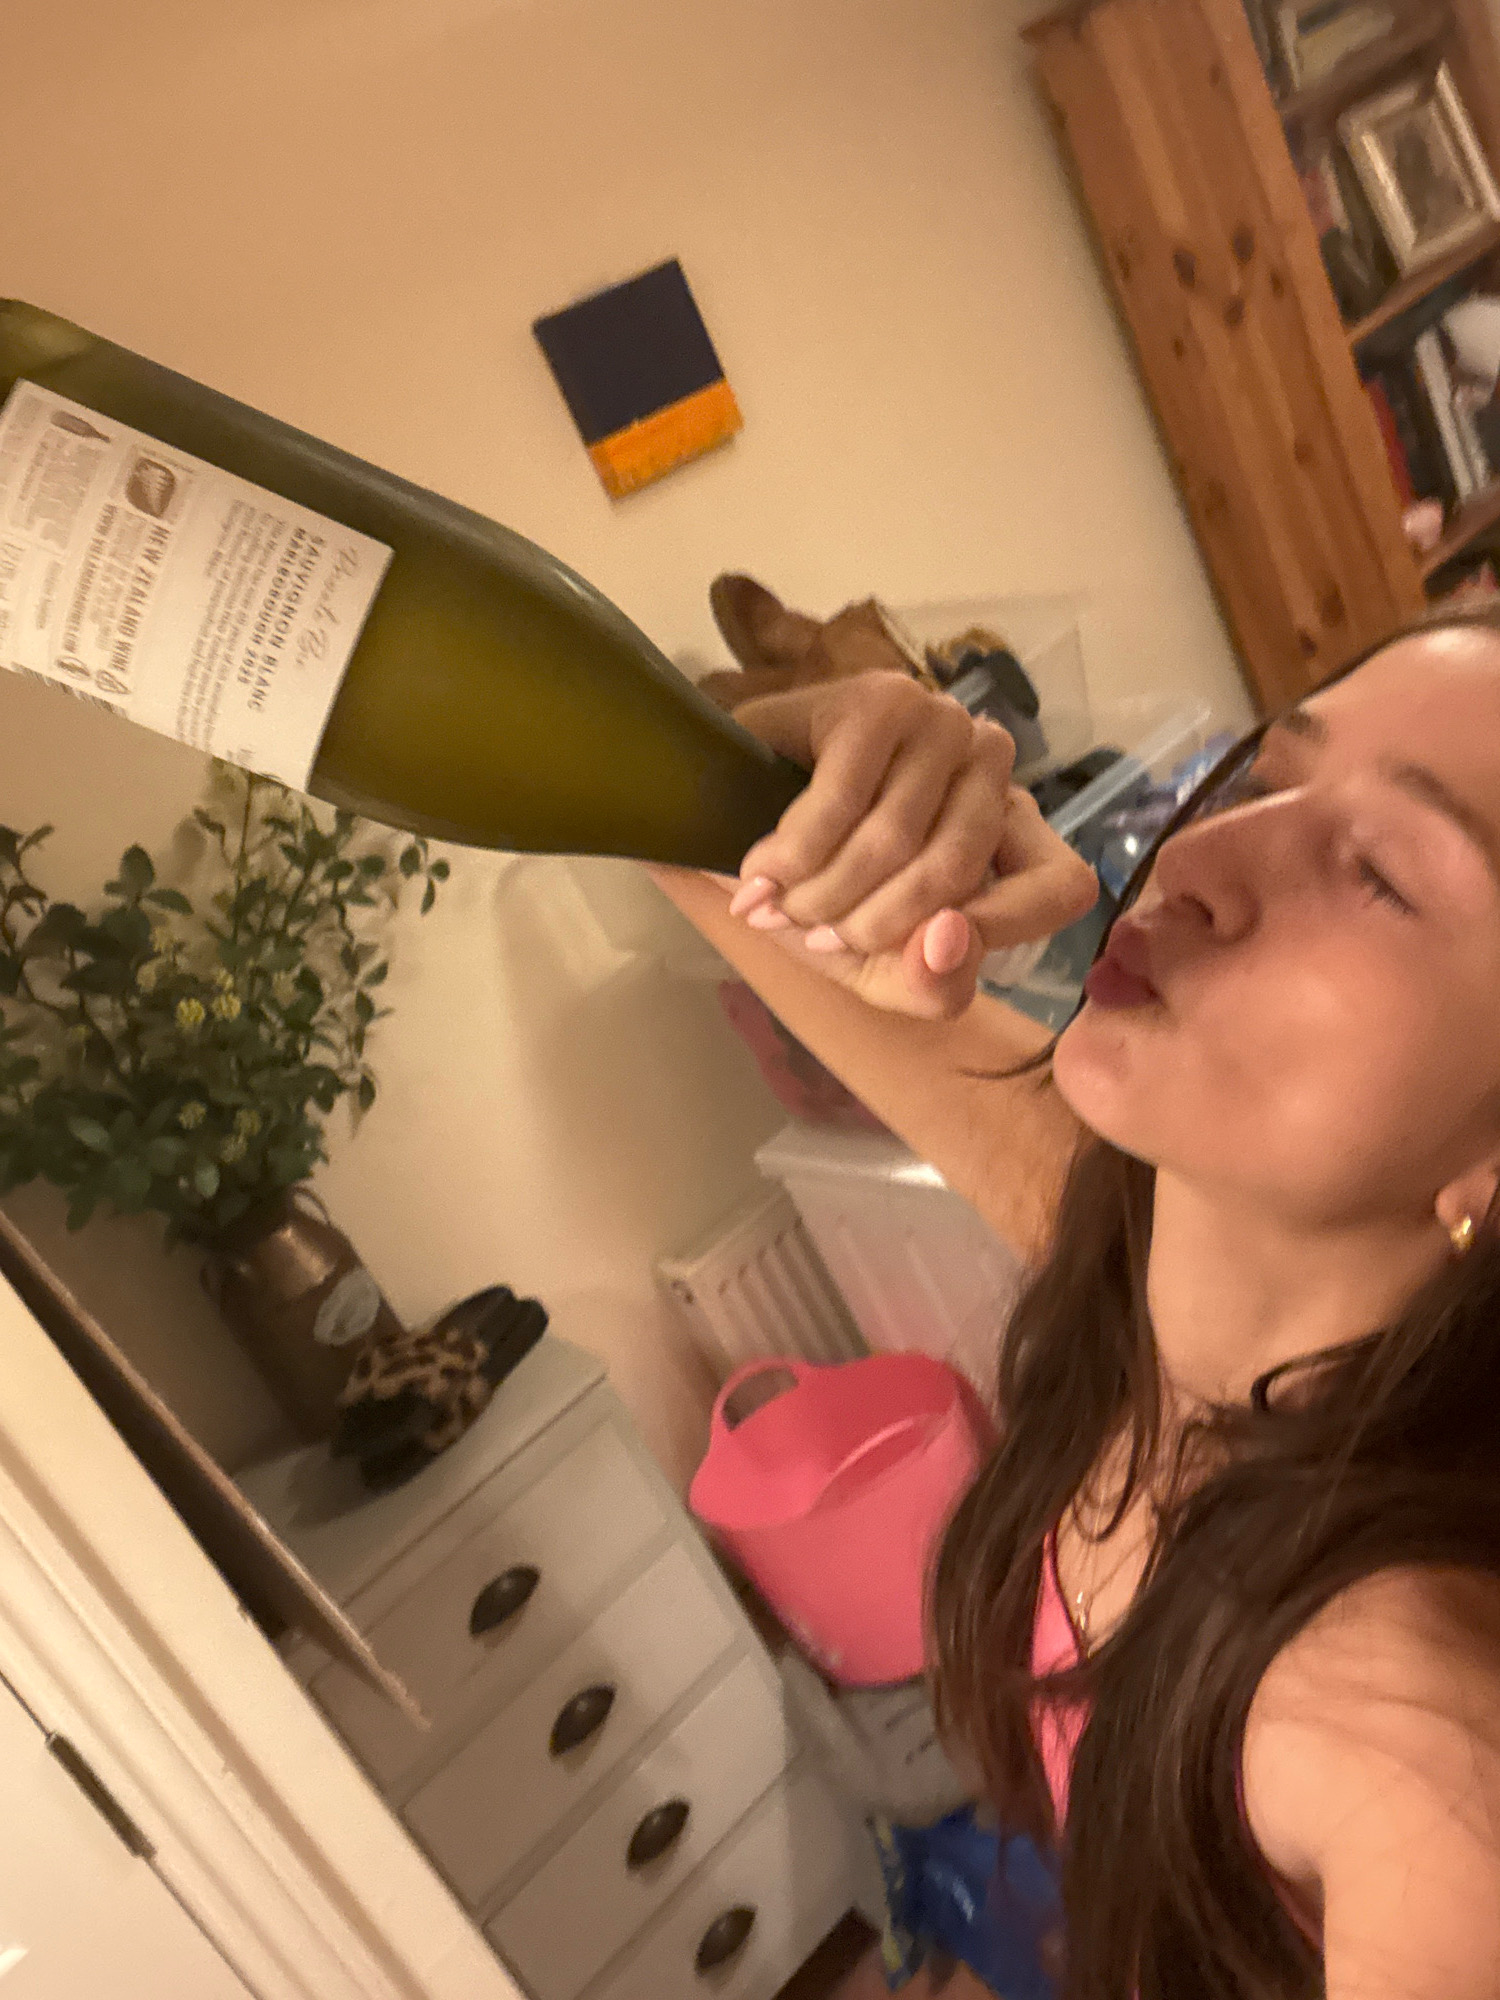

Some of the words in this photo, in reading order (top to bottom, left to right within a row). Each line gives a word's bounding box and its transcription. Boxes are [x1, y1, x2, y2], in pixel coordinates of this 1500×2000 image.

[139, 523, 172, 566] NEW
[116, 564, 156, 639] ZEALAND
[249, 526, 307, 646] MARLBOROUGH
[267, 534, 328, 651] SAUVIGNON
[245, 653, 279, 713] BLANC
